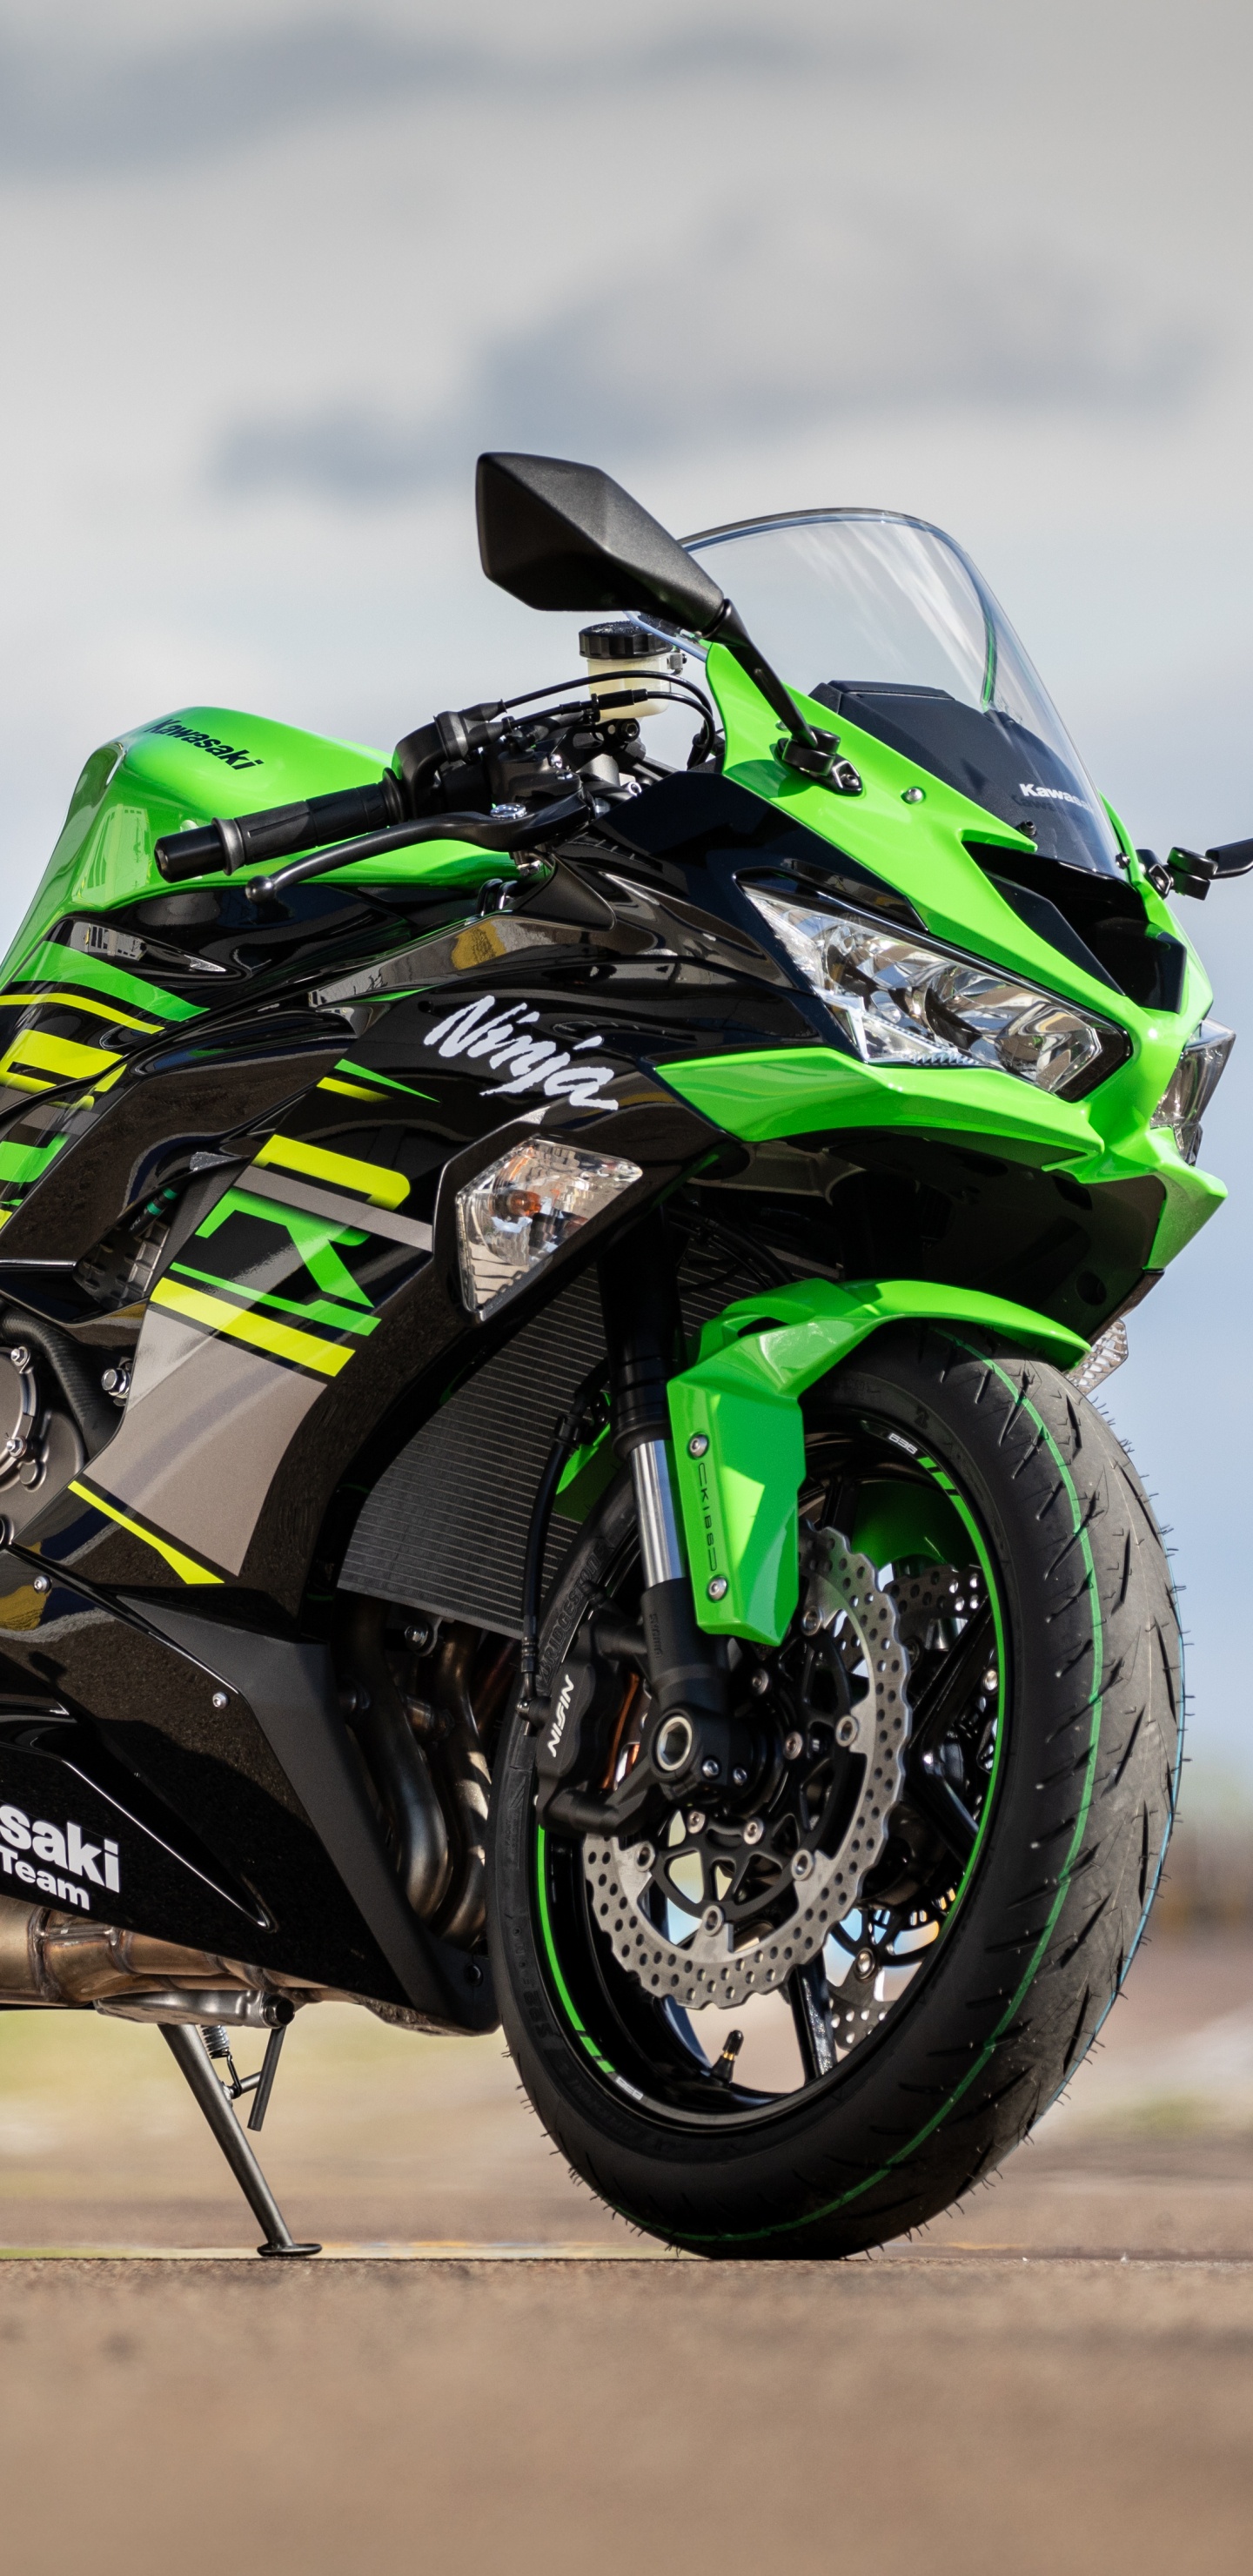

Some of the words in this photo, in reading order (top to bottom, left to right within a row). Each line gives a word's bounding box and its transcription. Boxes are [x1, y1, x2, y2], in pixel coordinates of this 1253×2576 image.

[144, 719, 265, 770] Kawasaki
[423, 995, 619, 1110] Ninja
[888, 1432, 918, 1454] 636
[700, 1487, 714, 1546] KIBS
[538, 1541, 607, 1680] BRIDGESTONE
[547, 1674, 574, 1758] NISSIN
[0, 1804, 120, 1893] saki
[0, 1844, 90, 1910] Team
